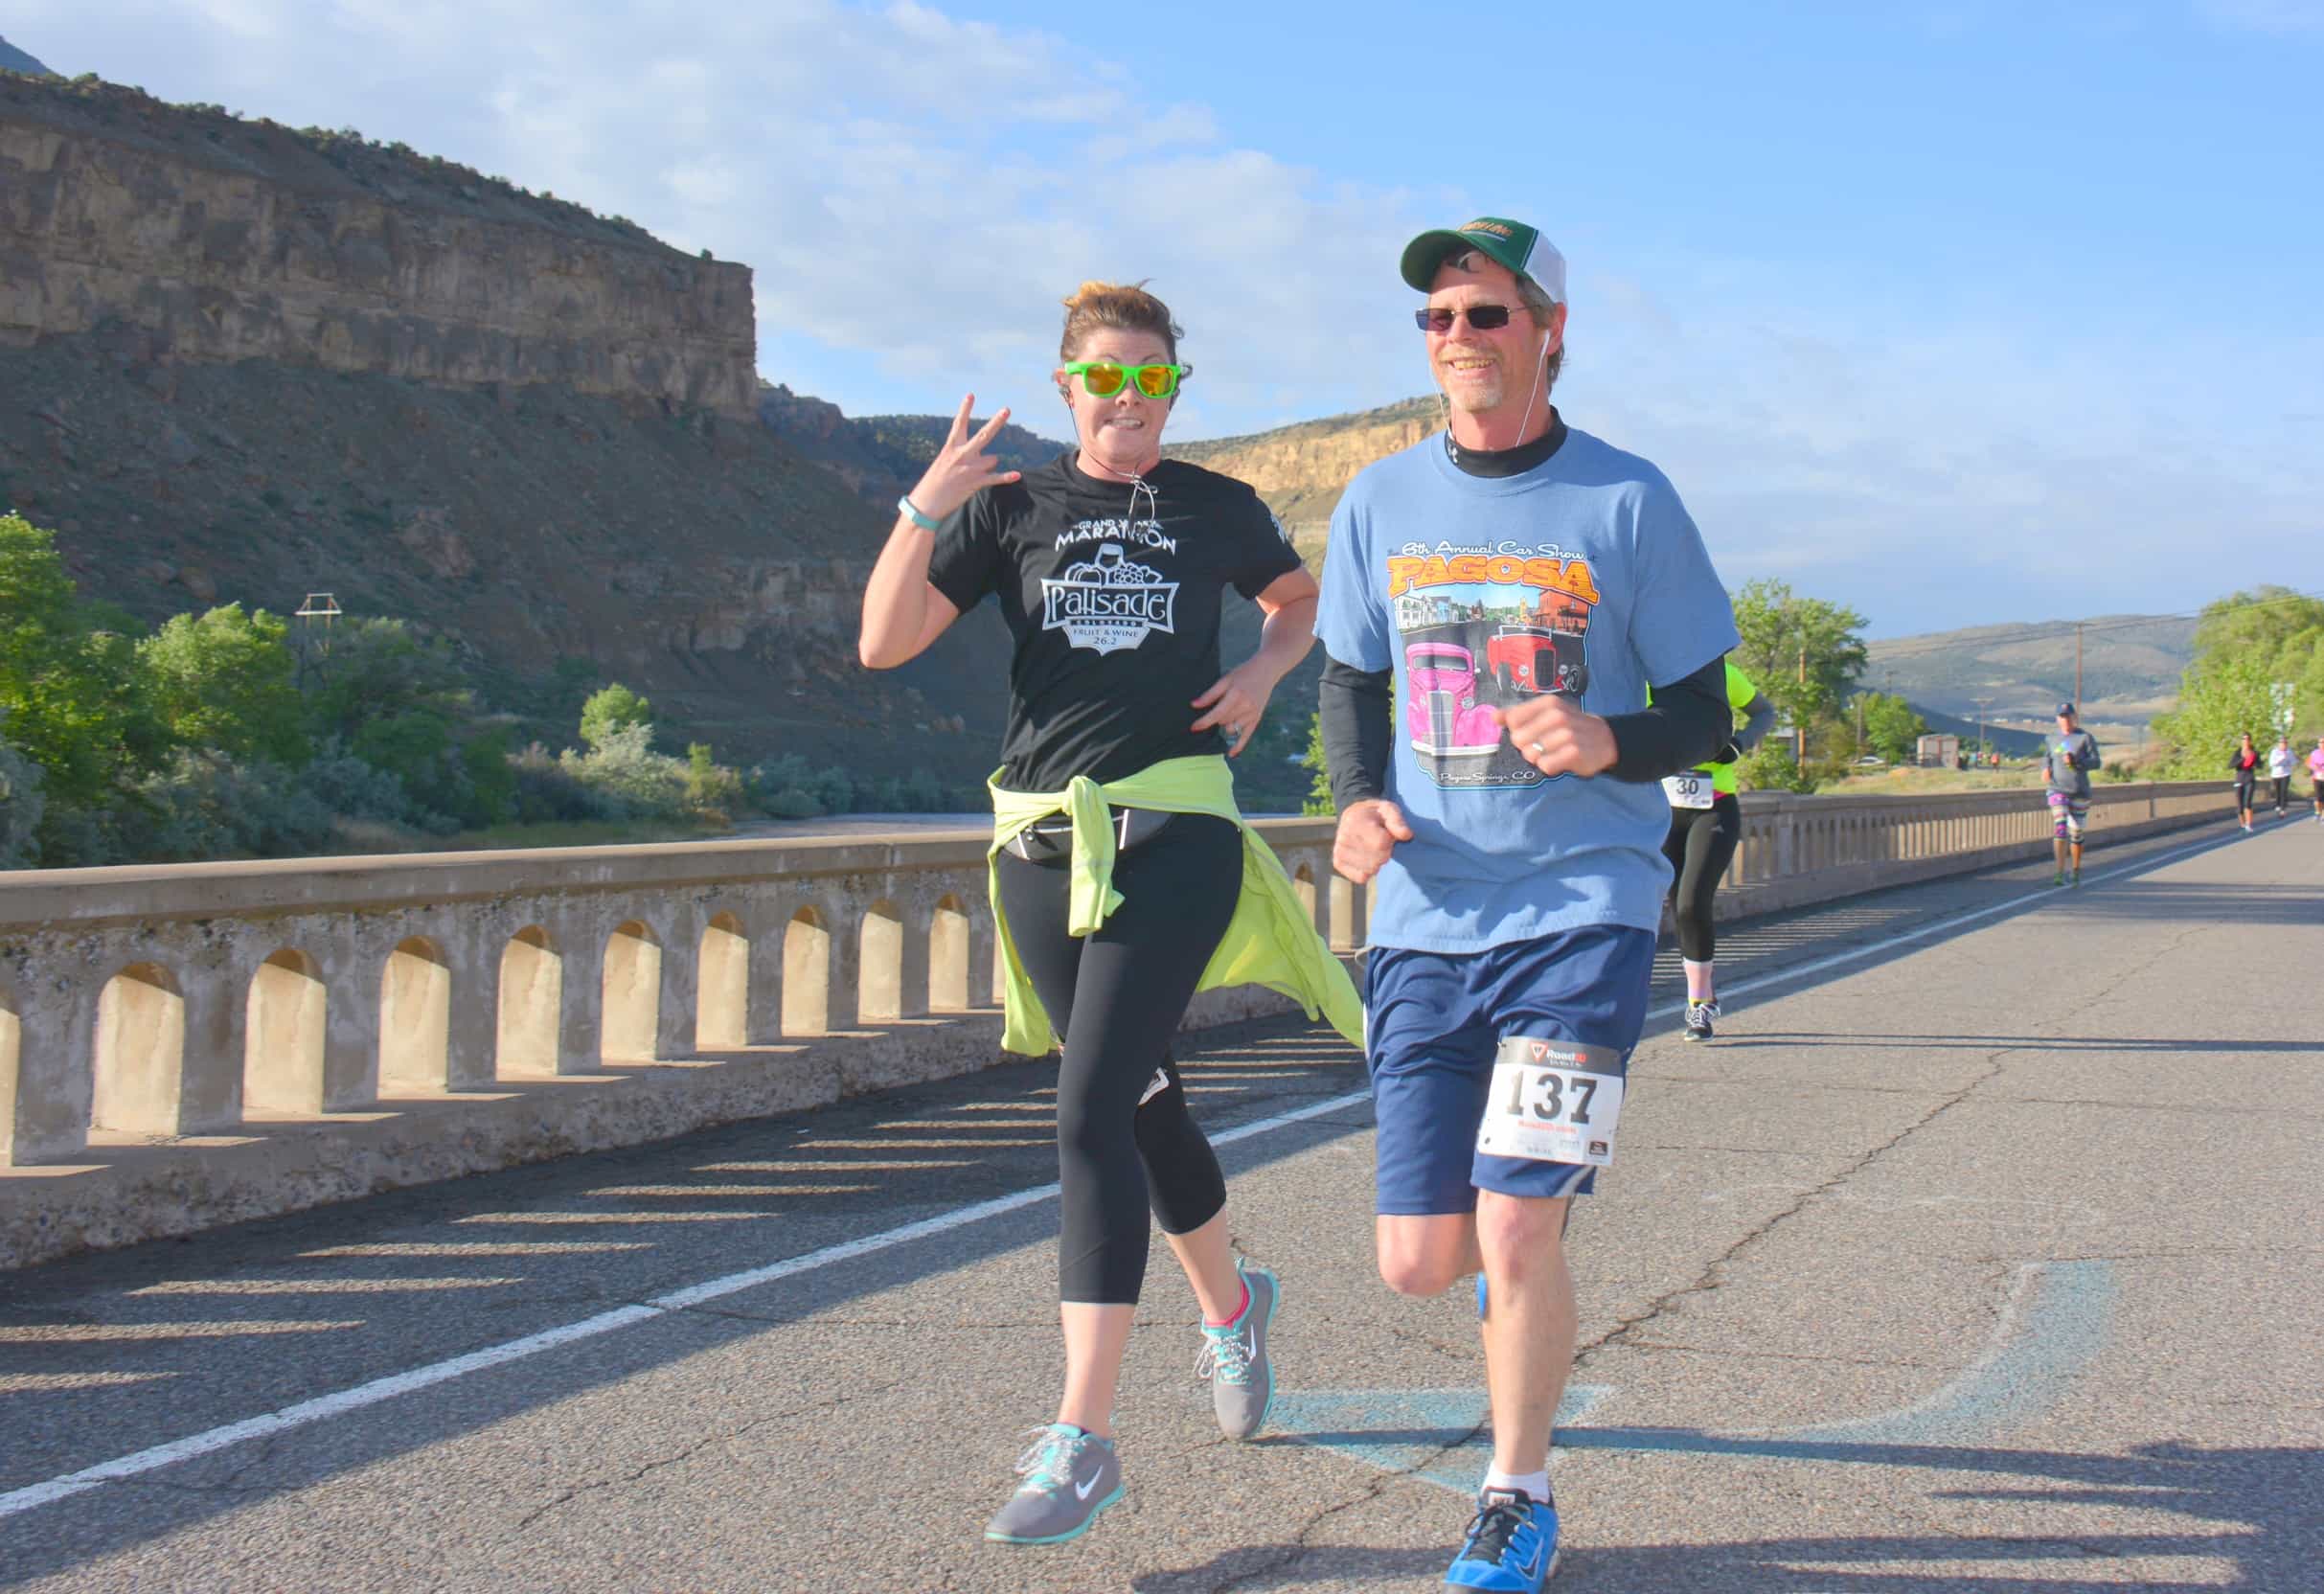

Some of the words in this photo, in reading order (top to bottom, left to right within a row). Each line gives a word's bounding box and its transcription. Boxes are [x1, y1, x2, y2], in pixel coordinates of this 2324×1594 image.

[1079, 519, 1115, 529] GRAND
[1435, 540, 1493, 555] Annual
[1496, 540, 1534, 556] Car
[1538, 543, 1587, 559] Show
[1387, 555, 1600, 605] PAGOSA
[1052, 586, 1166, 621] Palisade
[1111, 629, 1138, 638] WINE
[1512, 770, 1536, 780] CO
[1676, 779, 1698, 794] 30
[1507, 1070, 1598, 1124] 137
